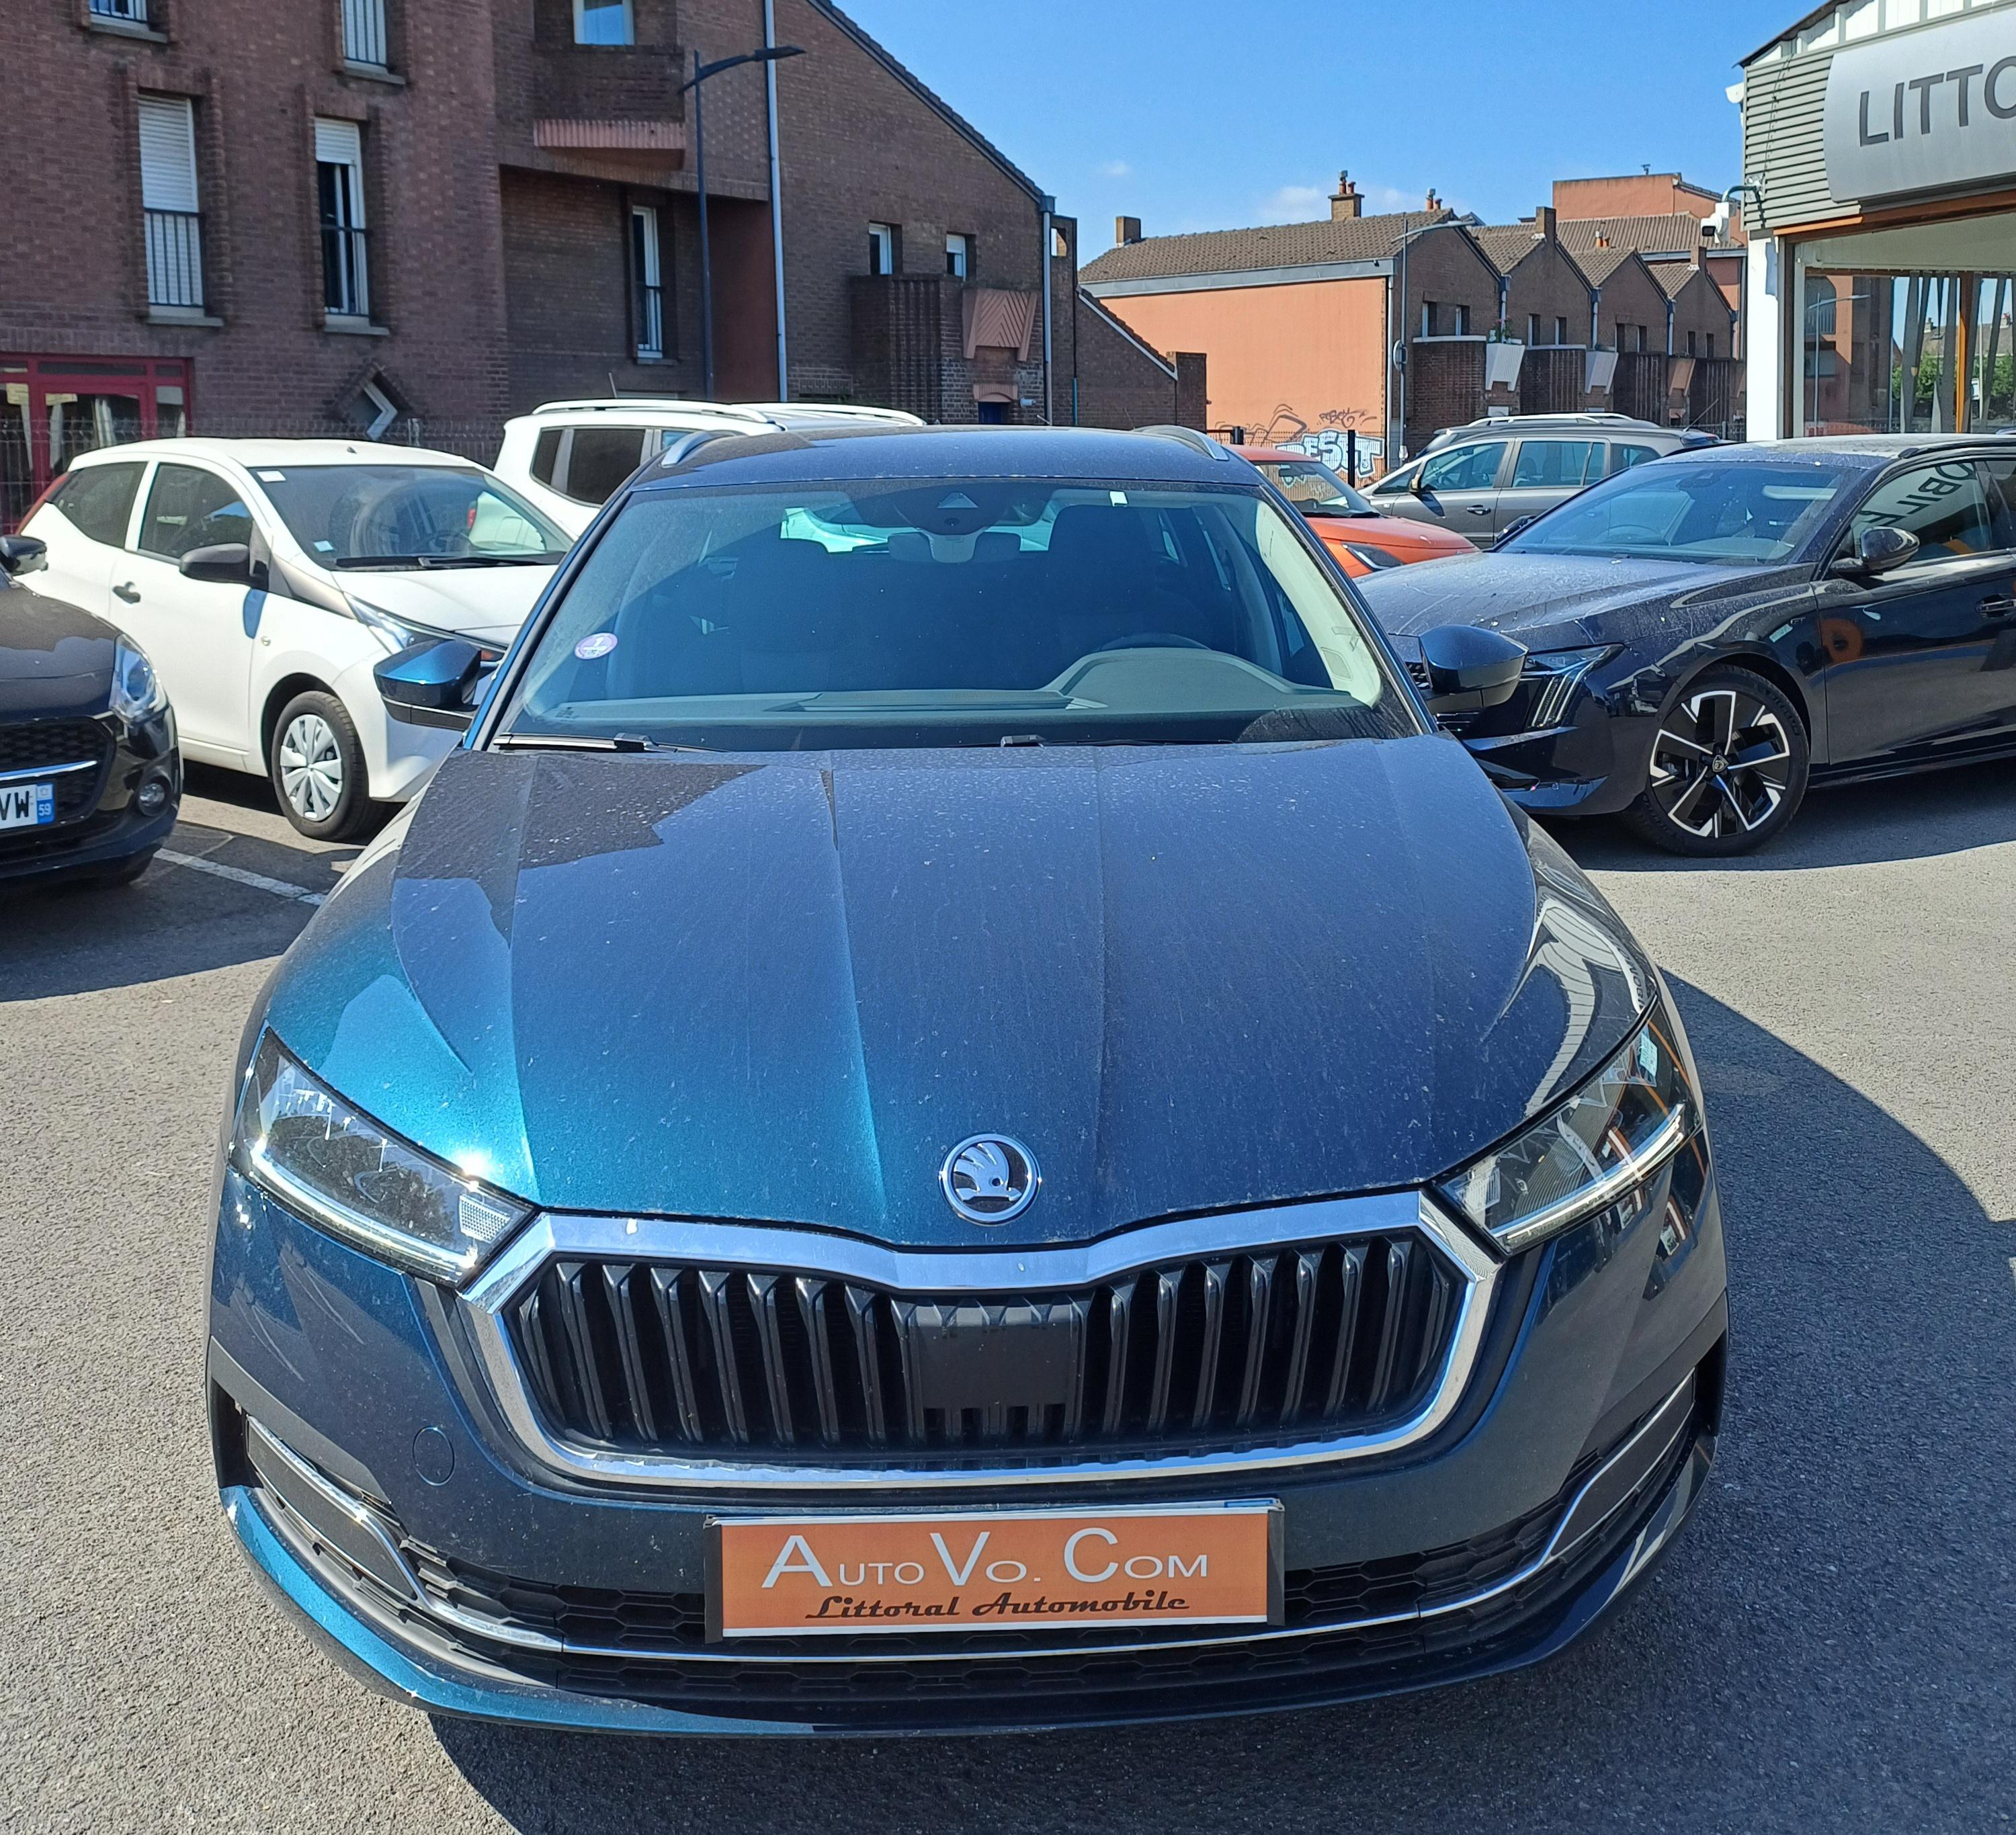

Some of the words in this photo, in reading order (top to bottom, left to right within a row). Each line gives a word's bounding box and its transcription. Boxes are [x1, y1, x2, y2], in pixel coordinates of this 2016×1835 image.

[38, 803, 52, 816] 59
[804, 1595, 960, 1619] Littoral
[972, 1589, 1190, 1617] Automobile
